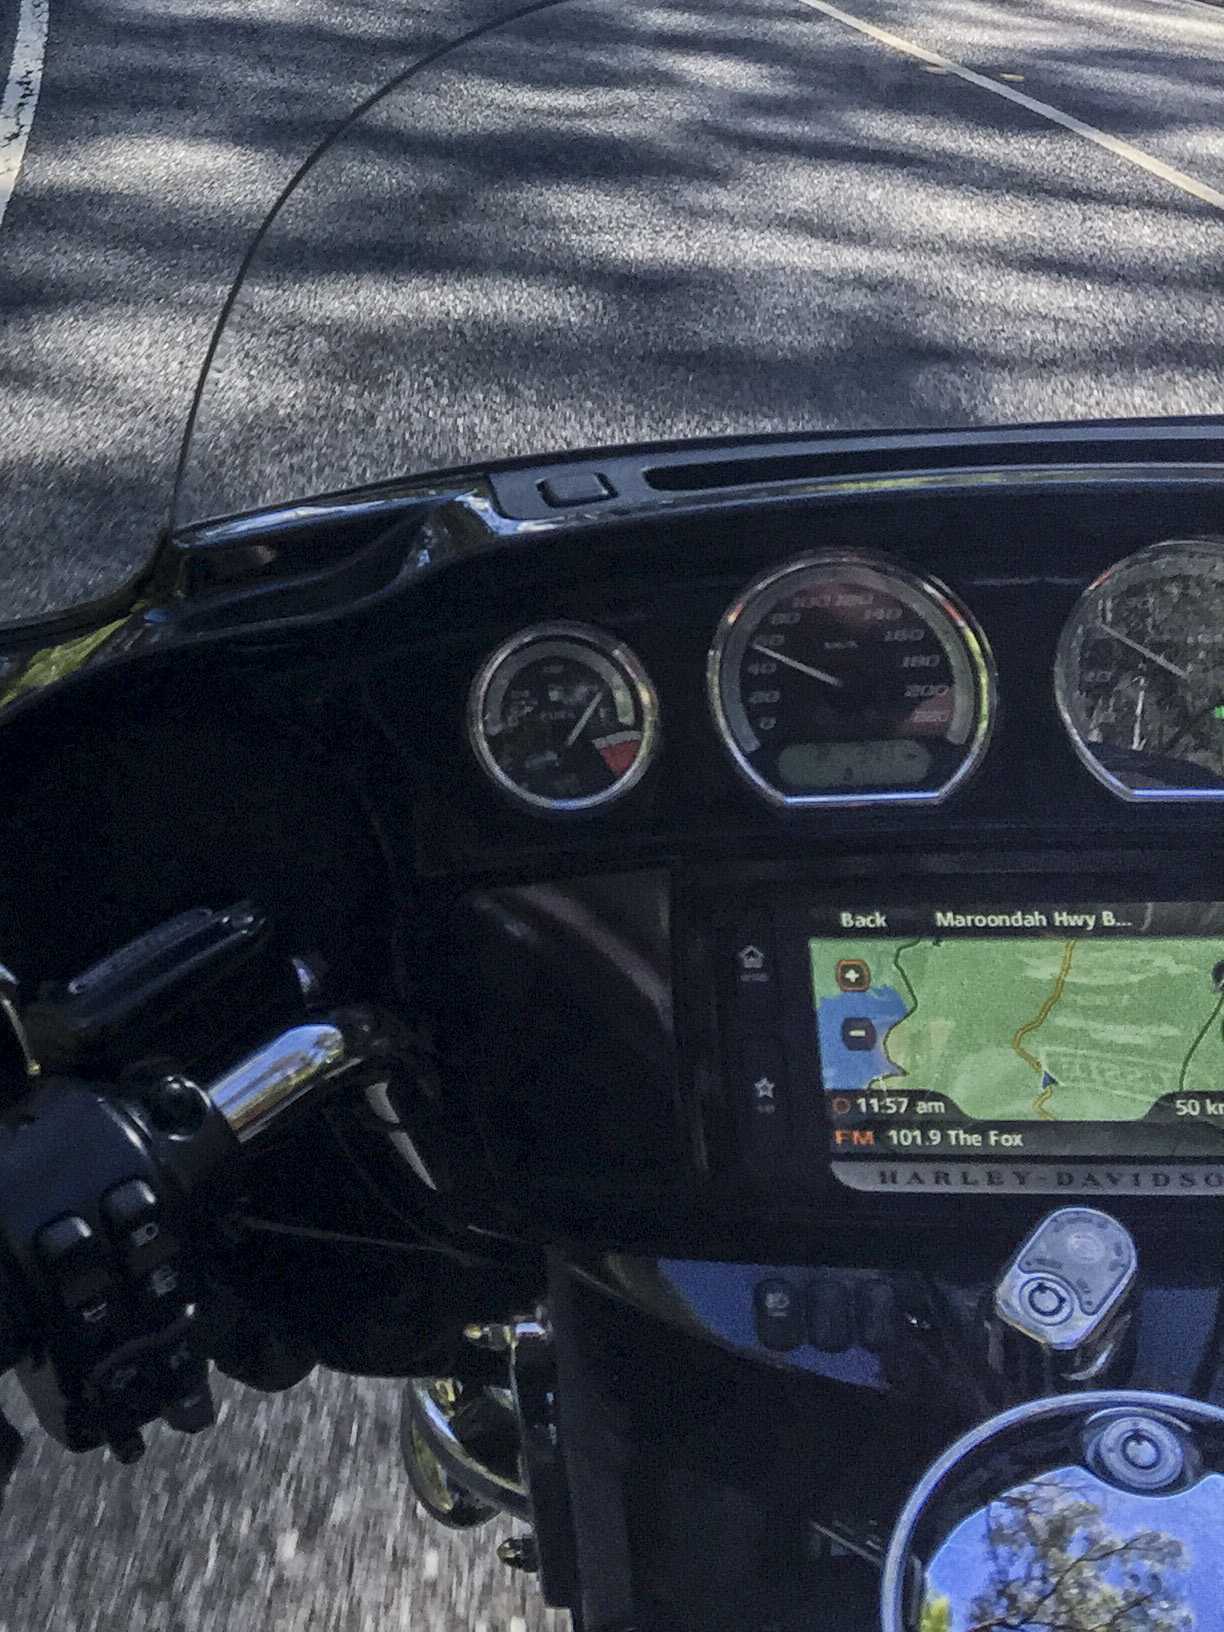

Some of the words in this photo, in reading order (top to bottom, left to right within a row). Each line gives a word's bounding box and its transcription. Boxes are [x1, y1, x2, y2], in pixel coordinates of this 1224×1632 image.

[903, 684, 949, 697] 200
[840, 911, 887, 928] Back
[935, 910, 1047, 928] Maroondah
[1053, 911, 1096, 930] Hwy
[856, 1097, 908, 1114] 11:57
[915, 1100, 945, 1114] am
[1175, 1099, 1200, 1115] 50
[834, 1130, 874, 1145] FM
[888, 1130, 941, 1146] 101.9
[947, 1130, 982, 1146] The
[988, 1131, 1024, 1147] Fox
